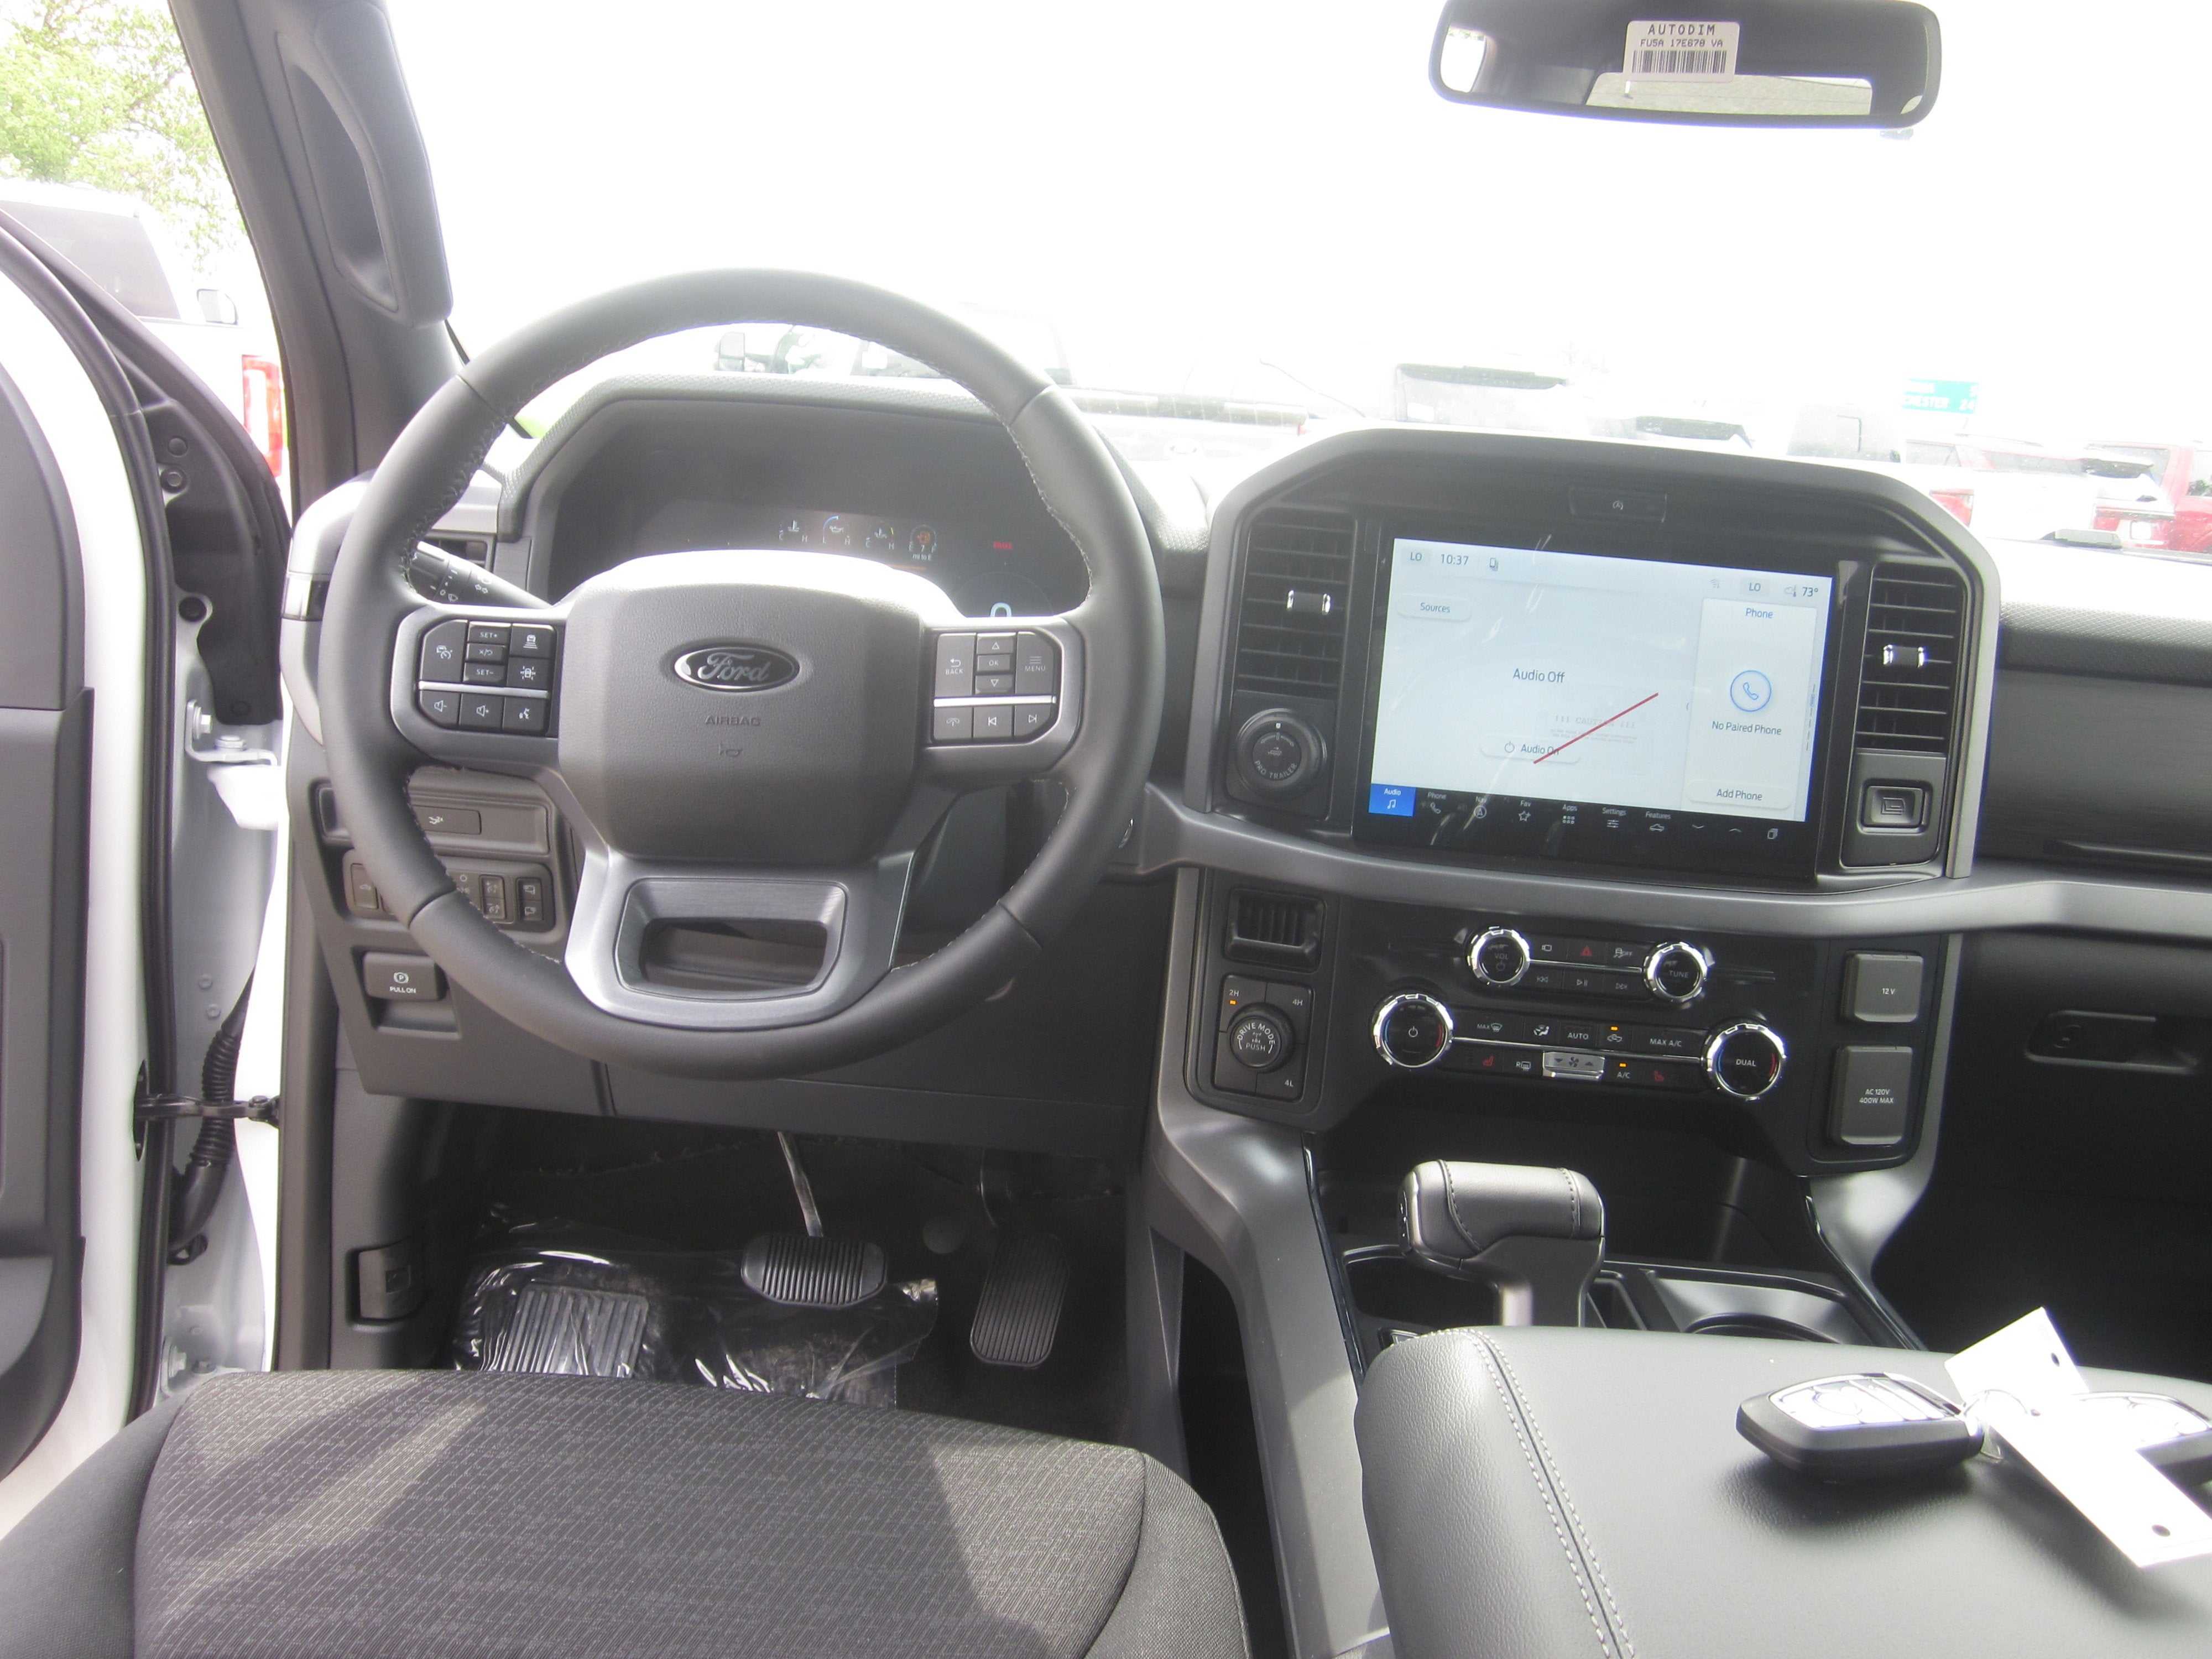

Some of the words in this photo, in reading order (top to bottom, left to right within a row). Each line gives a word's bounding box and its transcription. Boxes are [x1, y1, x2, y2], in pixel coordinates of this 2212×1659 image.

[1647, 24, 1715, 36] AUTODIM
[1711, 39, 1723, 47] VA
[1959, 399, 1976, 410] 24
[1410, 552, 1422, 562] LO
[1441, 554, 1469, 566] 10:37
[1749, 582, 1761, 592] LO
[1420, 602, 1451, 613] Sources
[1745, 608, 1773, 619] Phone
[697, 651, 771, 681] Ford
[1512, 668, 1545, 681] Audio
[1548, 671, 1566, 683] Off
[705, 716, 761, 726] AIRBAG
[1712, 721, 1724, 730] No
[1726, 722, 1753, 733] Paired
[1754, 724, 1782, 735] Phone
[1521, 744, 1546, 754] Audio
[1547, 746, 1559, 755] On
[1254, 760, 1267, 775] PRO
[1269, 763, 1297, 779] TRAILER
[1384, 787, 1402, 796] Audio
[1427, 791, 1447, 800] Phone
[1716, 789, 1734, 799] Add
[1735, 790, 1763, 801] Phone
[1562, 804, 1578, 812] Apps
[1602, 807, 1627, 817] Settings
[1645, 811, 1672, 820] Features
[1668, 970, 1688, 978] TUNE
[1229, 989, 1240, 997] 2H
[1237, 1022, 1256, 1041] DRIVE
[1258, 1023, 1276, 1045] MODE
[1567, 1032, 1589, 1040] AUTO
[1245, 1042, 1266, 1051] PUSH
[1735, 1058, 1757, 1067] DUAL
